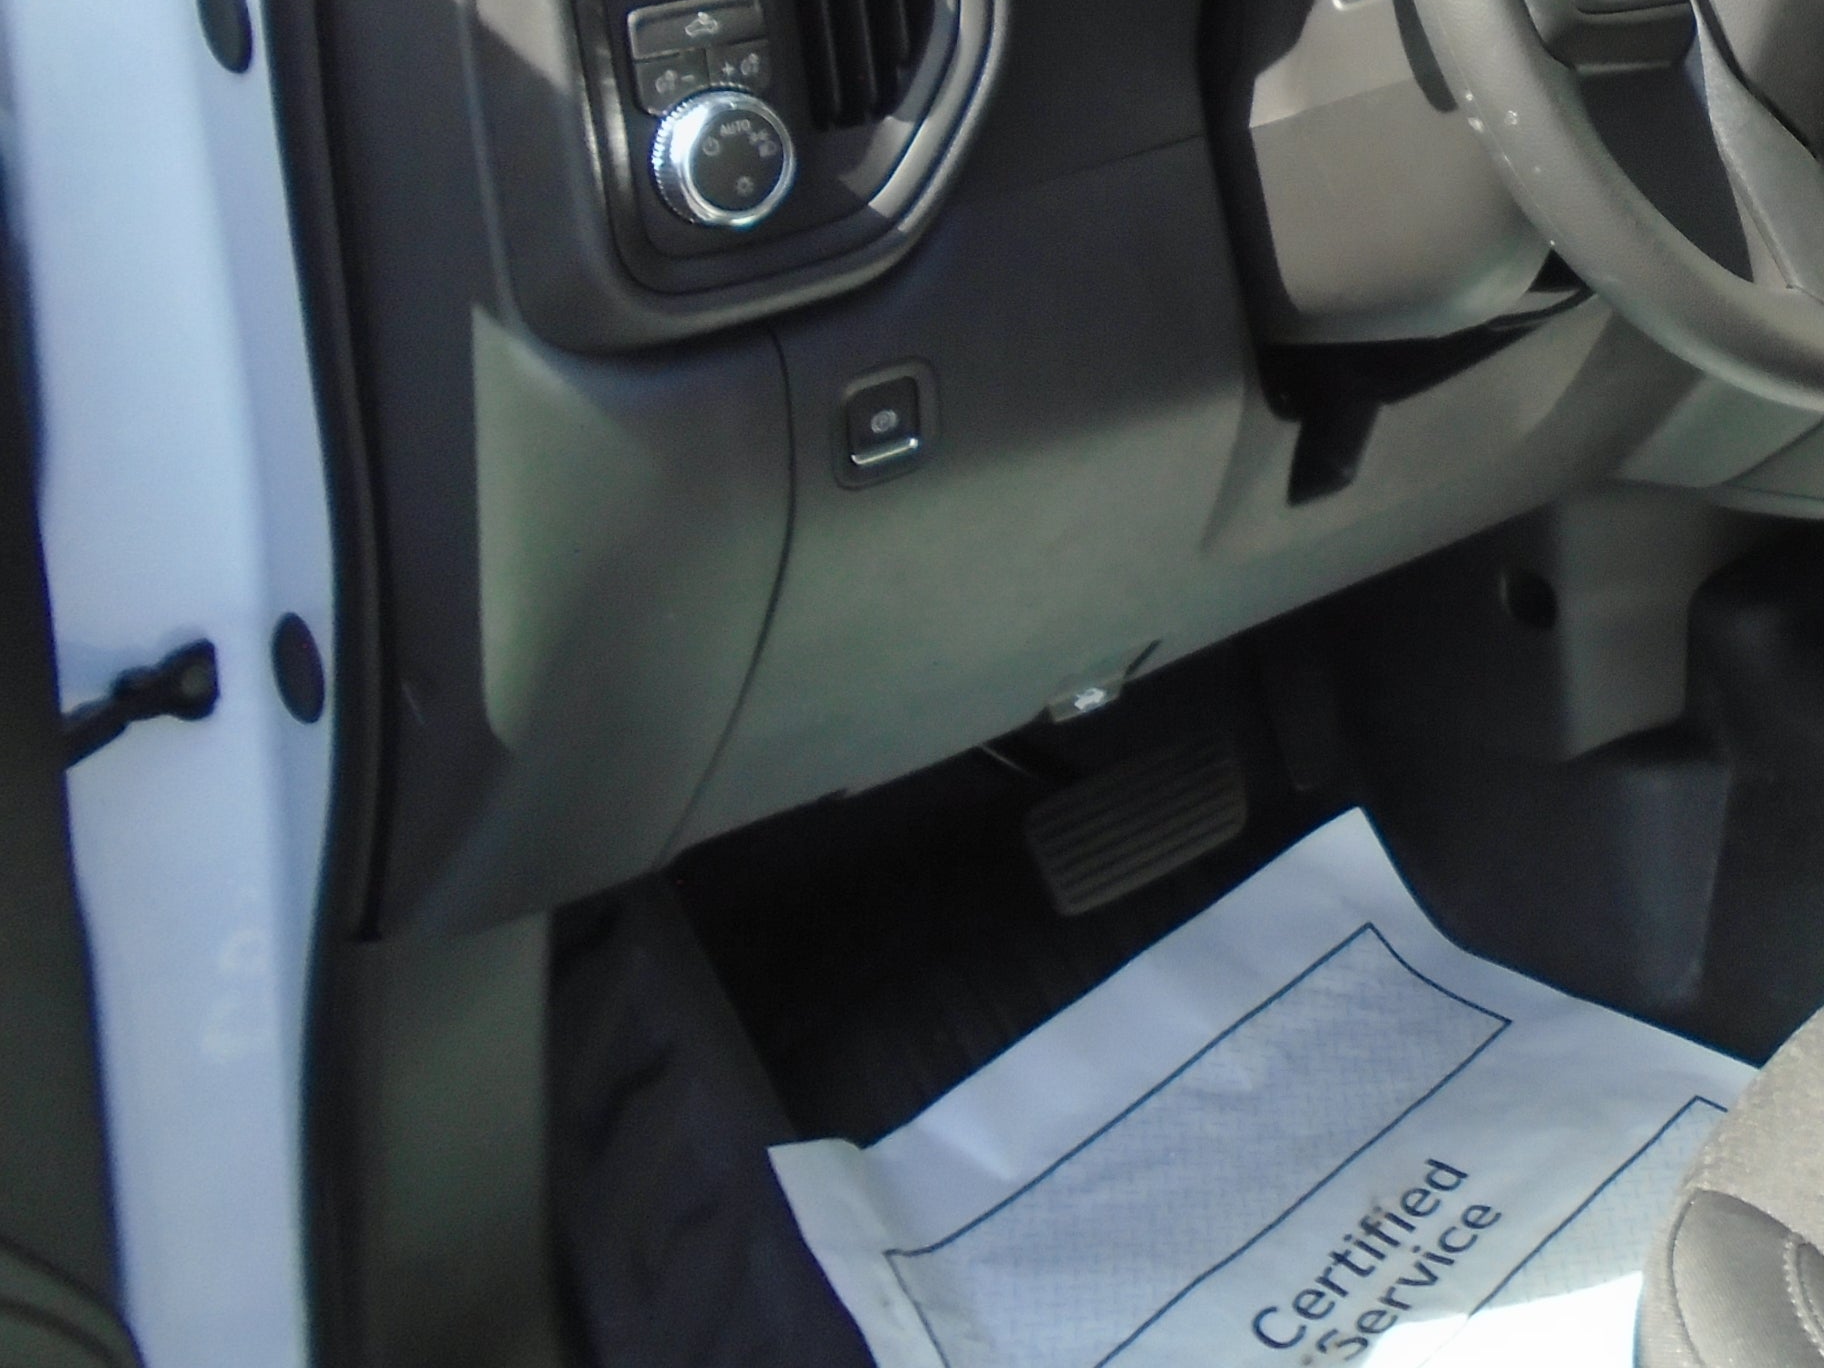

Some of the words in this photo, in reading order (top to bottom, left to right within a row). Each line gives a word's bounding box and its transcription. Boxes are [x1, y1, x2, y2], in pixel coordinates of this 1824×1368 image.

[720, 118, 752, 136] AUTO
[1251, 1157, 1469, 1350] Certified
[1314, 1203, 1502, 1362] Service
